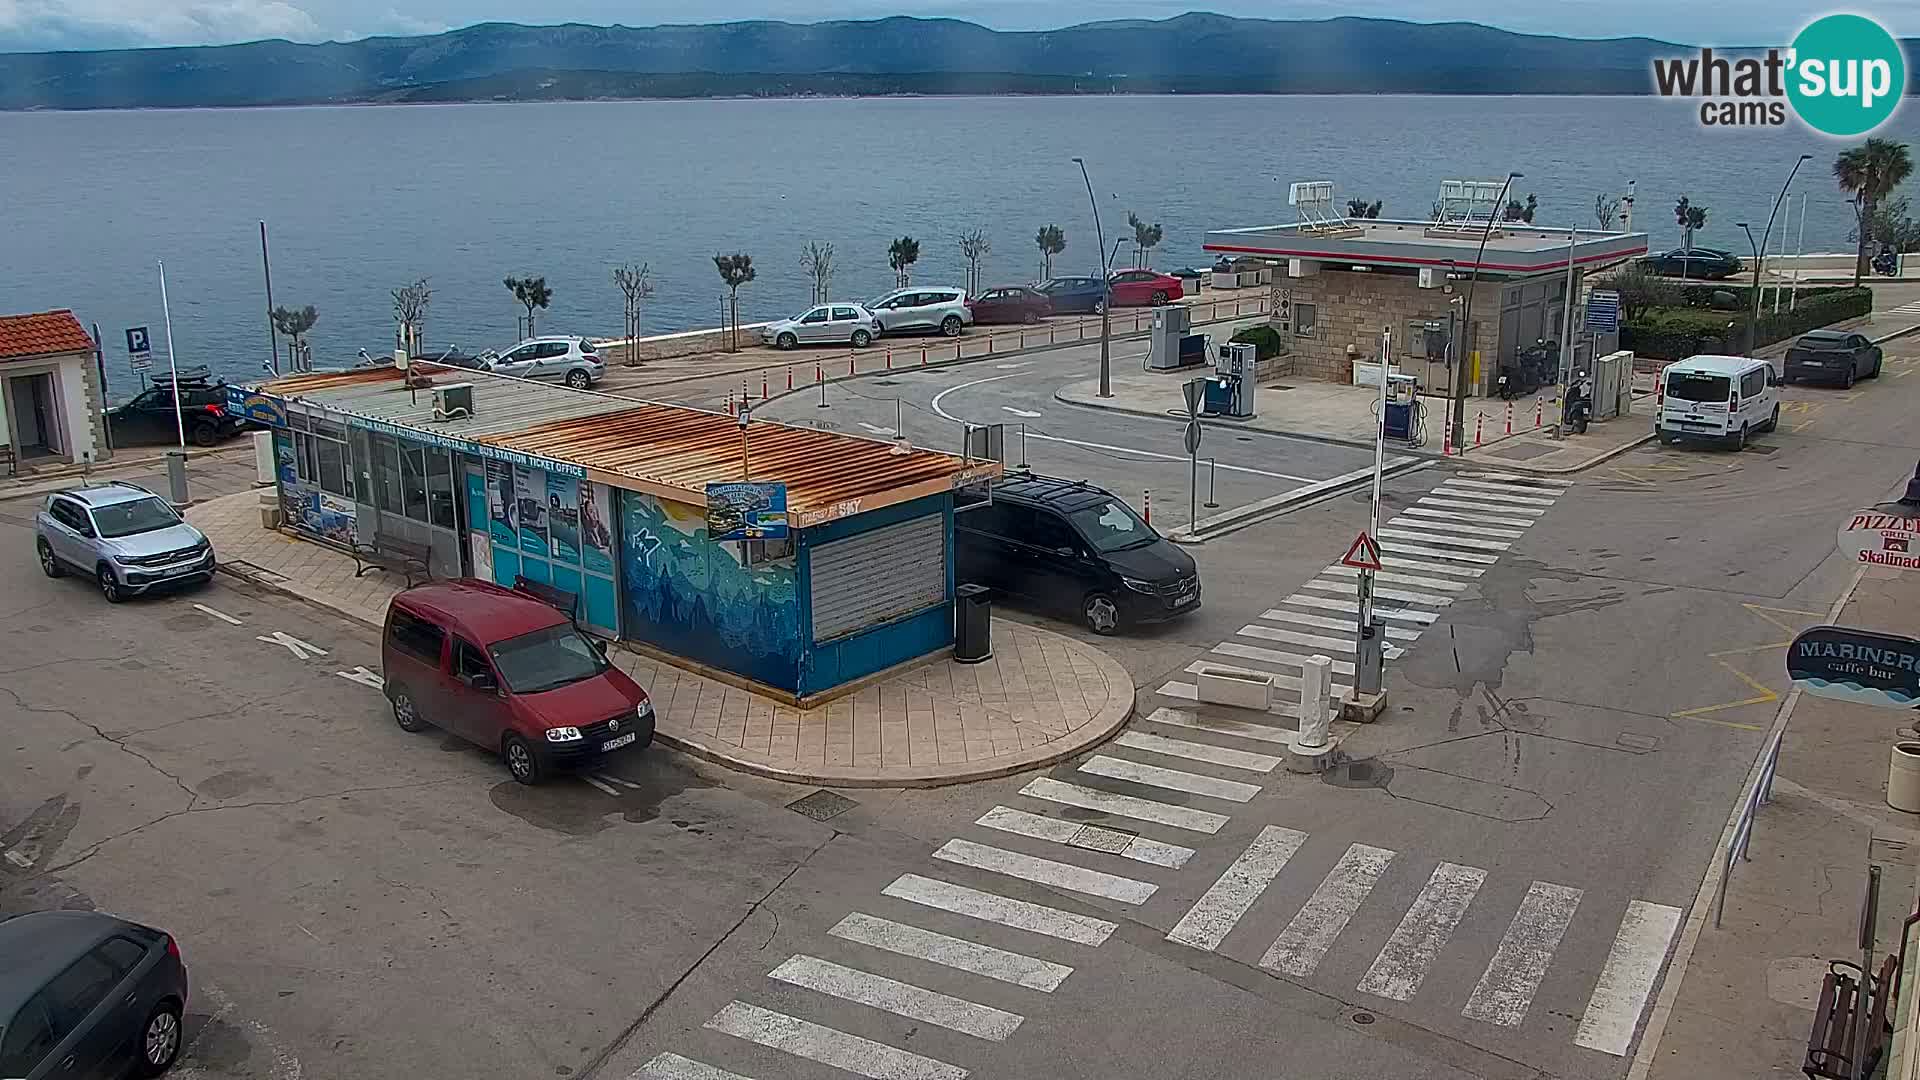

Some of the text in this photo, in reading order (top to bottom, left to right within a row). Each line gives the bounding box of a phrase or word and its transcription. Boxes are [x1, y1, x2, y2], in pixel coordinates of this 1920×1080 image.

[131, 330, 144, 349] P
[479, 446, 494, 457] BUS
[495, 450, 527, 464] STATION
[529, 456, 555, 470] TICKET
[556, 463, 583, 477] OFFICE
[1880, 530, 1915, 541] GRILL
[1828, 662, 1896, 680] caffe bar
